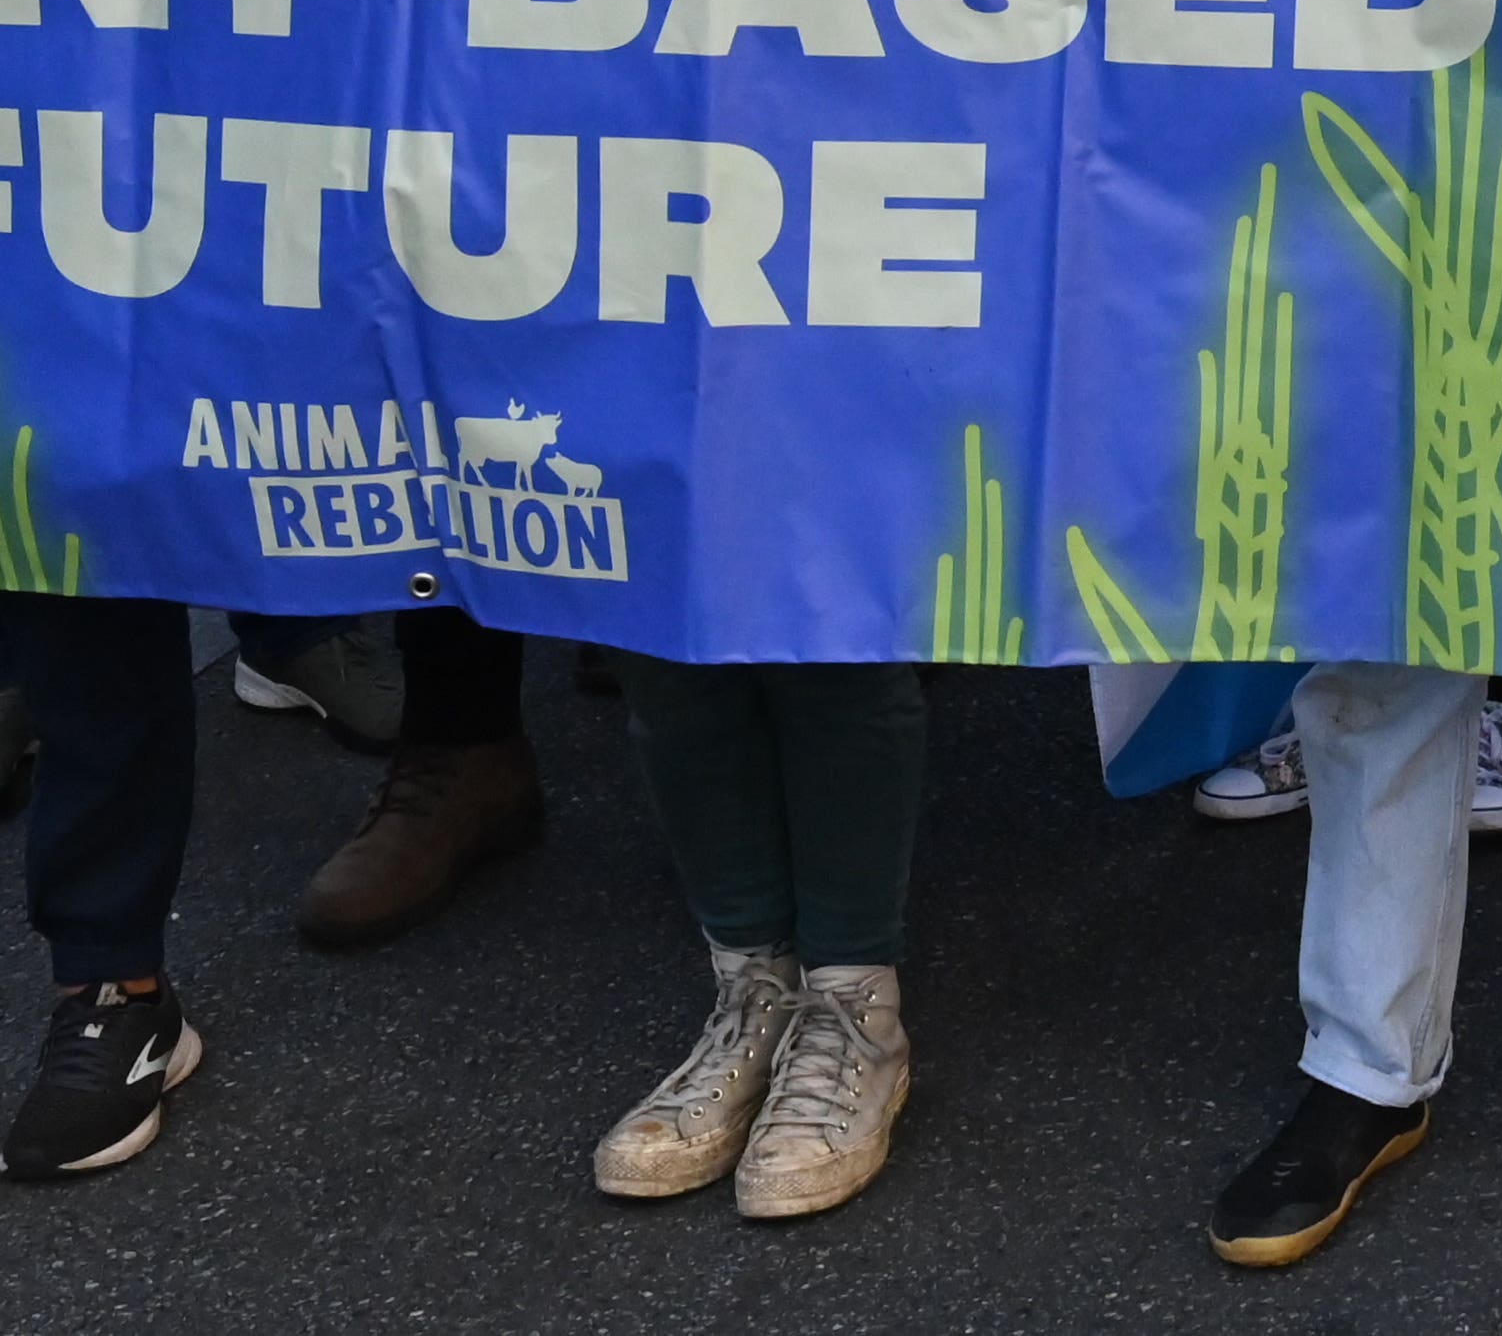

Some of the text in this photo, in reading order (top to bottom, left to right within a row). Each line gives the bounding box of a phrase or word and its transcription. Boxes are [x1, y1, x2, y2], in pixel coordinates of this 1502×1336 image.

[0, 109, 987, 328] UTURE
[183, 397, 451, 474] ANIMAL
[268, 475, 618, 574] REBELLION
